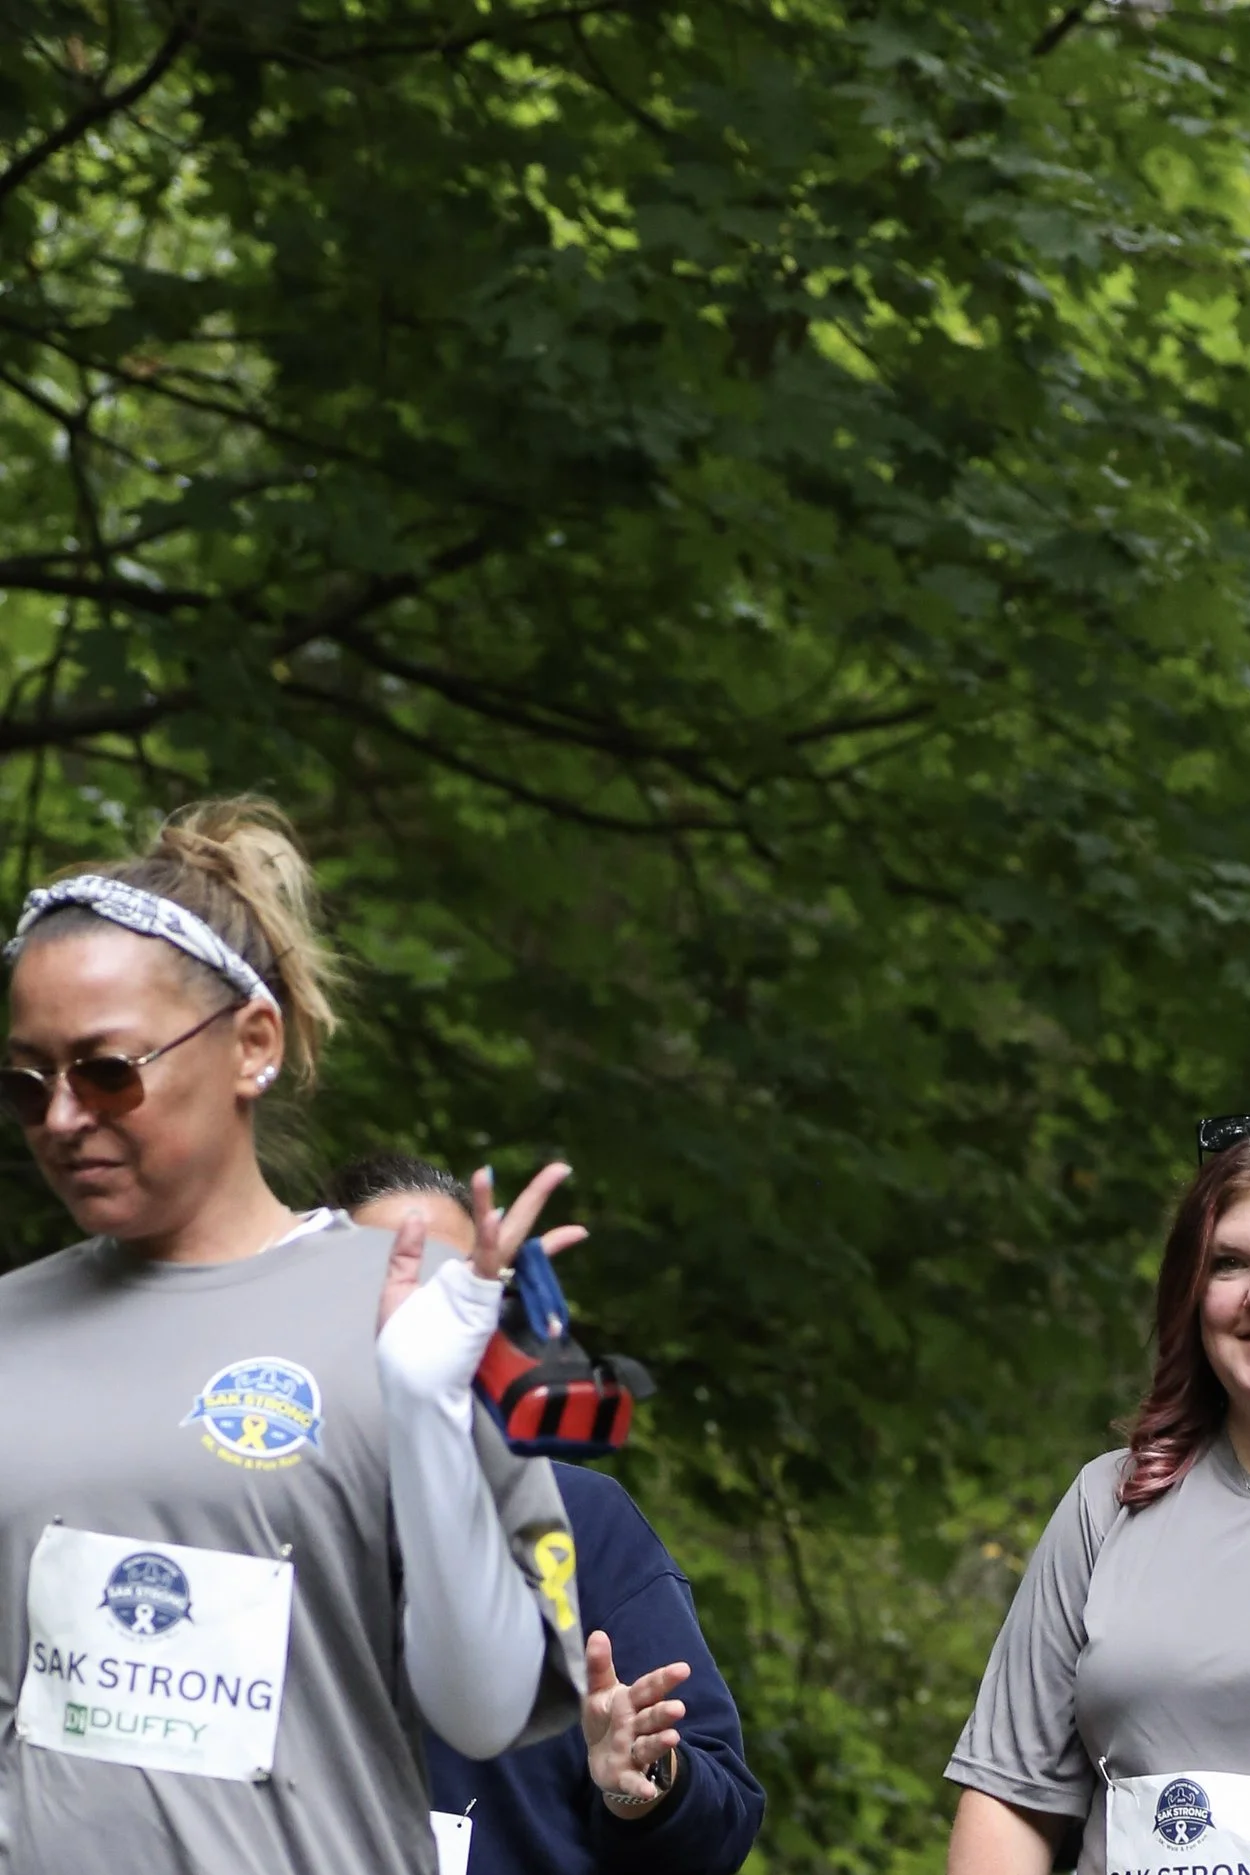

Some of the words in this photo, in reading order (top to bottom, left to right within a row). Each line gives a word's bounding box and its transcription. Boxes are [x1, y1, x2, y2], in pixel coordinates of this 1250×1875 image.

[244, 1395, 312, 1429] STRONG
[33, 1642, 88, 1685] SAK
[97, 1658, 273, 1712] STRONG
[91, 1707, 208, 1743] DUFFY
[1157, 1809, 1173, 1822] SAK
[1173, 1807, 1208, 1819] STRONG
